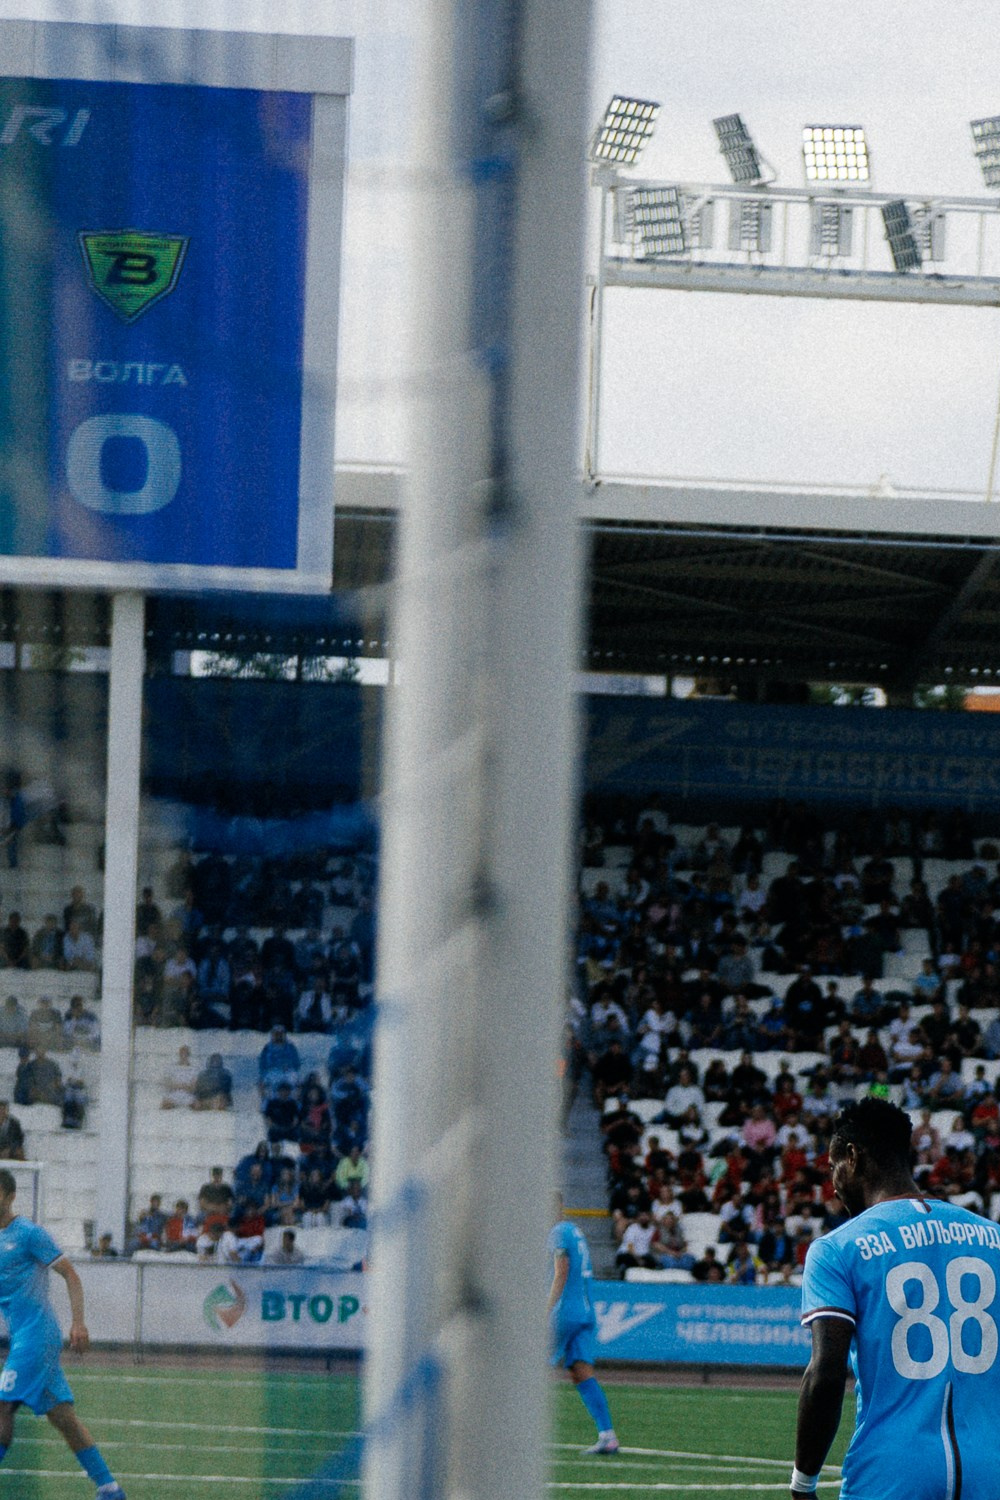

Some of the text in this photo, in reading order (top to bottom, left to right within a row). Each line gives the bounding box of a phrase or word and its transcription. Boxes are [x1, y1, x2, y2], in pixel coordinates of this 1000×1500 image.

[67, 358, 188, 387] ВОЛГА
[66, 413, 182, 516] 0
[724, 748, 1000, 790] ЧЕЛЯБИНСК
[855, 1231, 897, 1261] ЭЗА
[261, 1290, 366, 1324] ВТОР
[886, 1256, 999, 1380] 88
[676, 1321, 813, 1346] ЧЕЛЯБИНС
